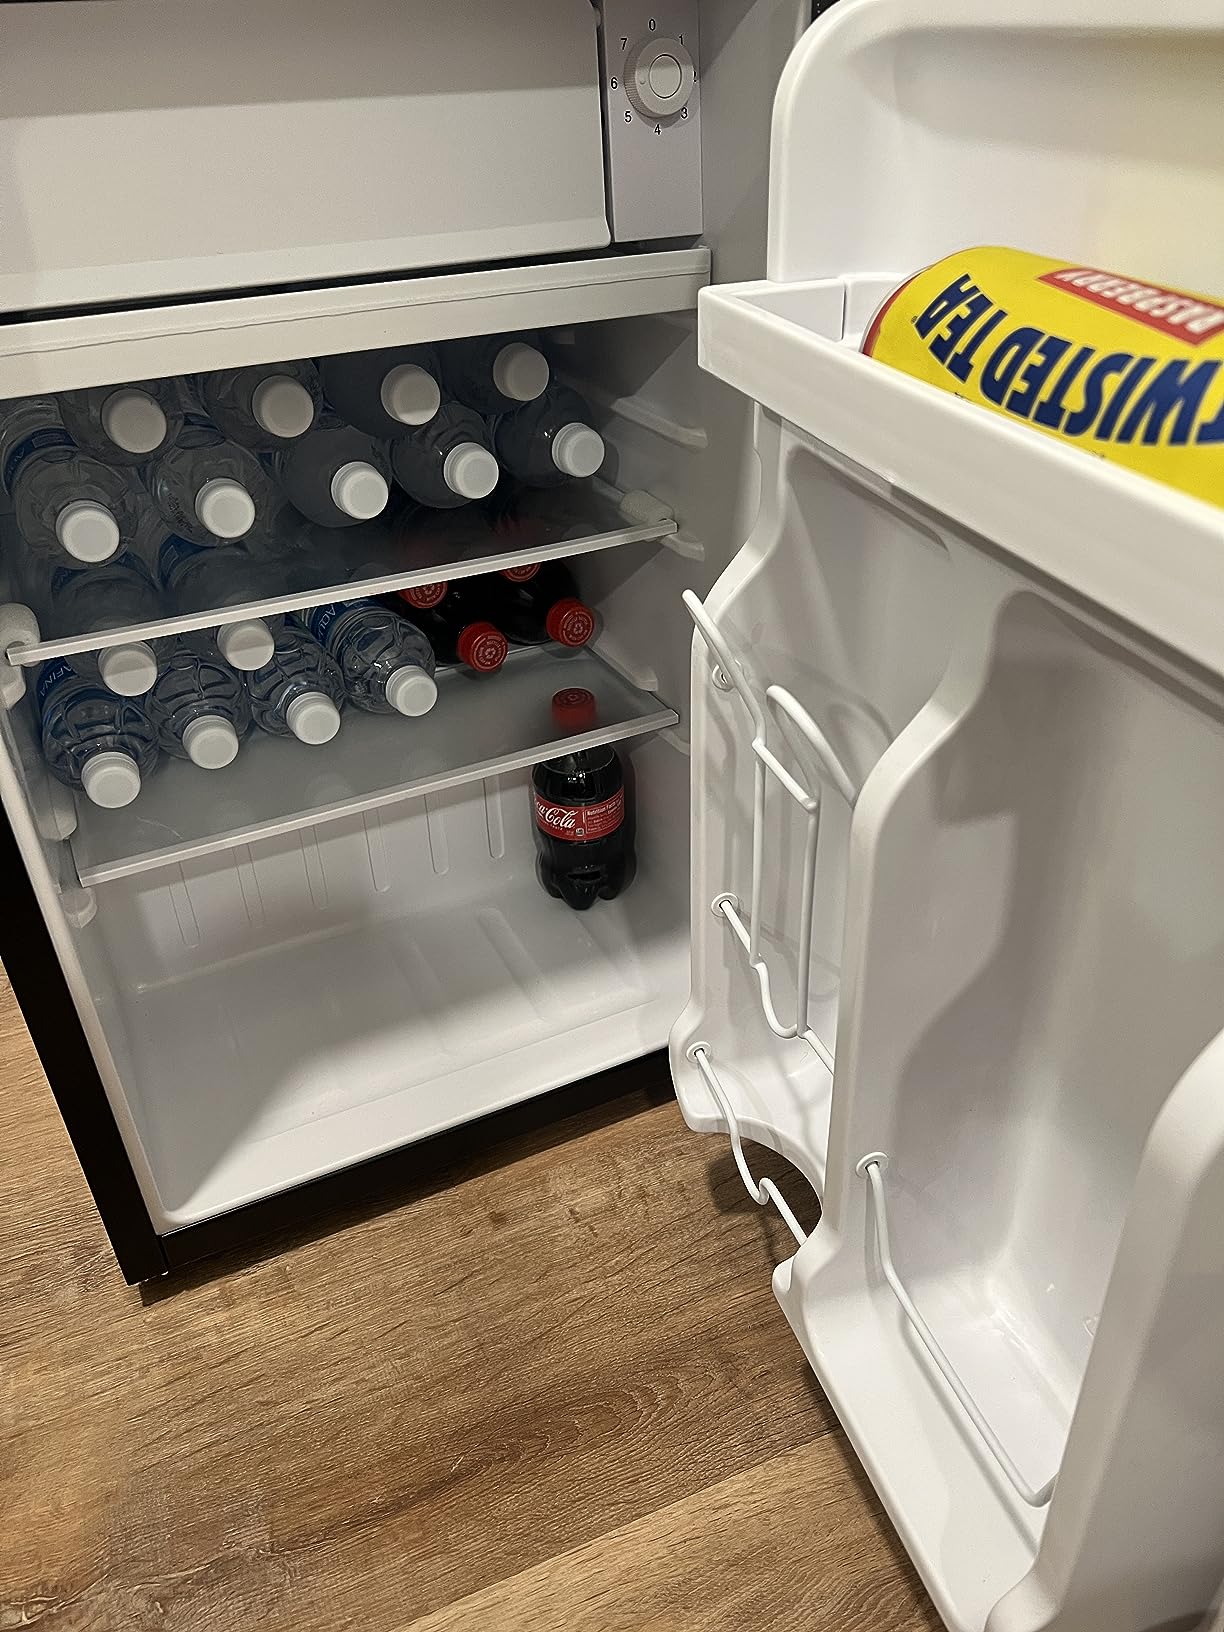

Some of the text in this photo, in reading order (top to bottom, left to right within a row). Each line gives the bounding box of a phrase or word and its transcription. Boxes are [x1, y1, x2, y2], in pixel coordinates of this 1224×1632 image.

[649, 18, 656, 31] 0
[620, 37, 628, 51] 7
[679, 34, 686, 46] 1
[611, 77, 619, 90] 6
[624, 109, 633, 123] 5
[680, 106, 688, 119] 3
[654, 123, 663, 136] 4
[913, 272, 1009, 384] TEA
